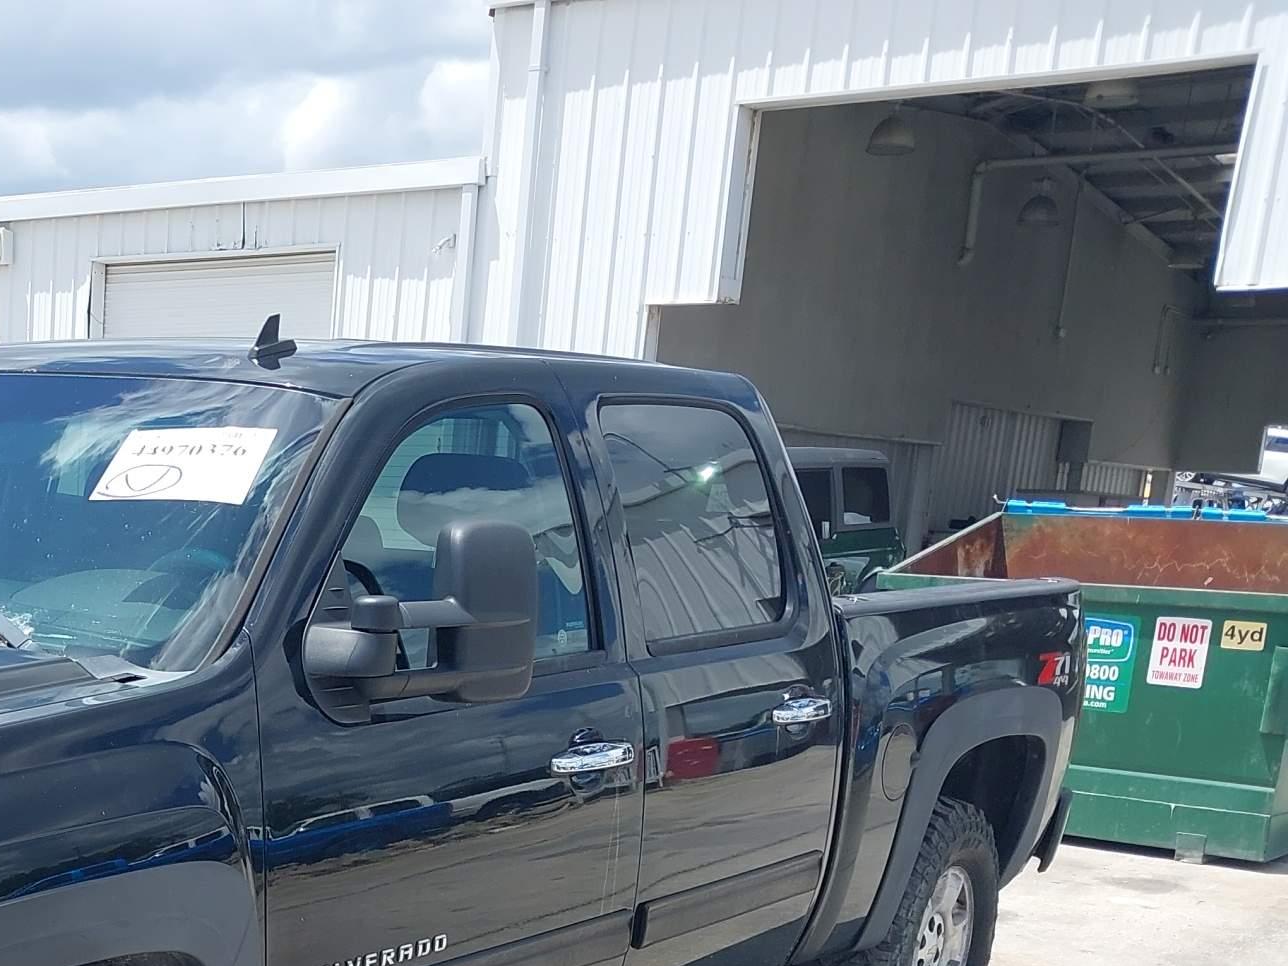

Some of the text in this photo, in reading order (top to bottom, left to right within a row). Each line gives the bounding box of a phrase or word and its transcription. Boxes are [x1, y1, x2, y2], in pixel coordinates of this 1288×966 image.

[1158, 622, 1209, 645] DO NOT
[1224, 625, 1264, 645] 4yd
[1159, 646, 1197, 668] PARK
[1152, 670, 1199, 683] TOWAWAY ZONE
